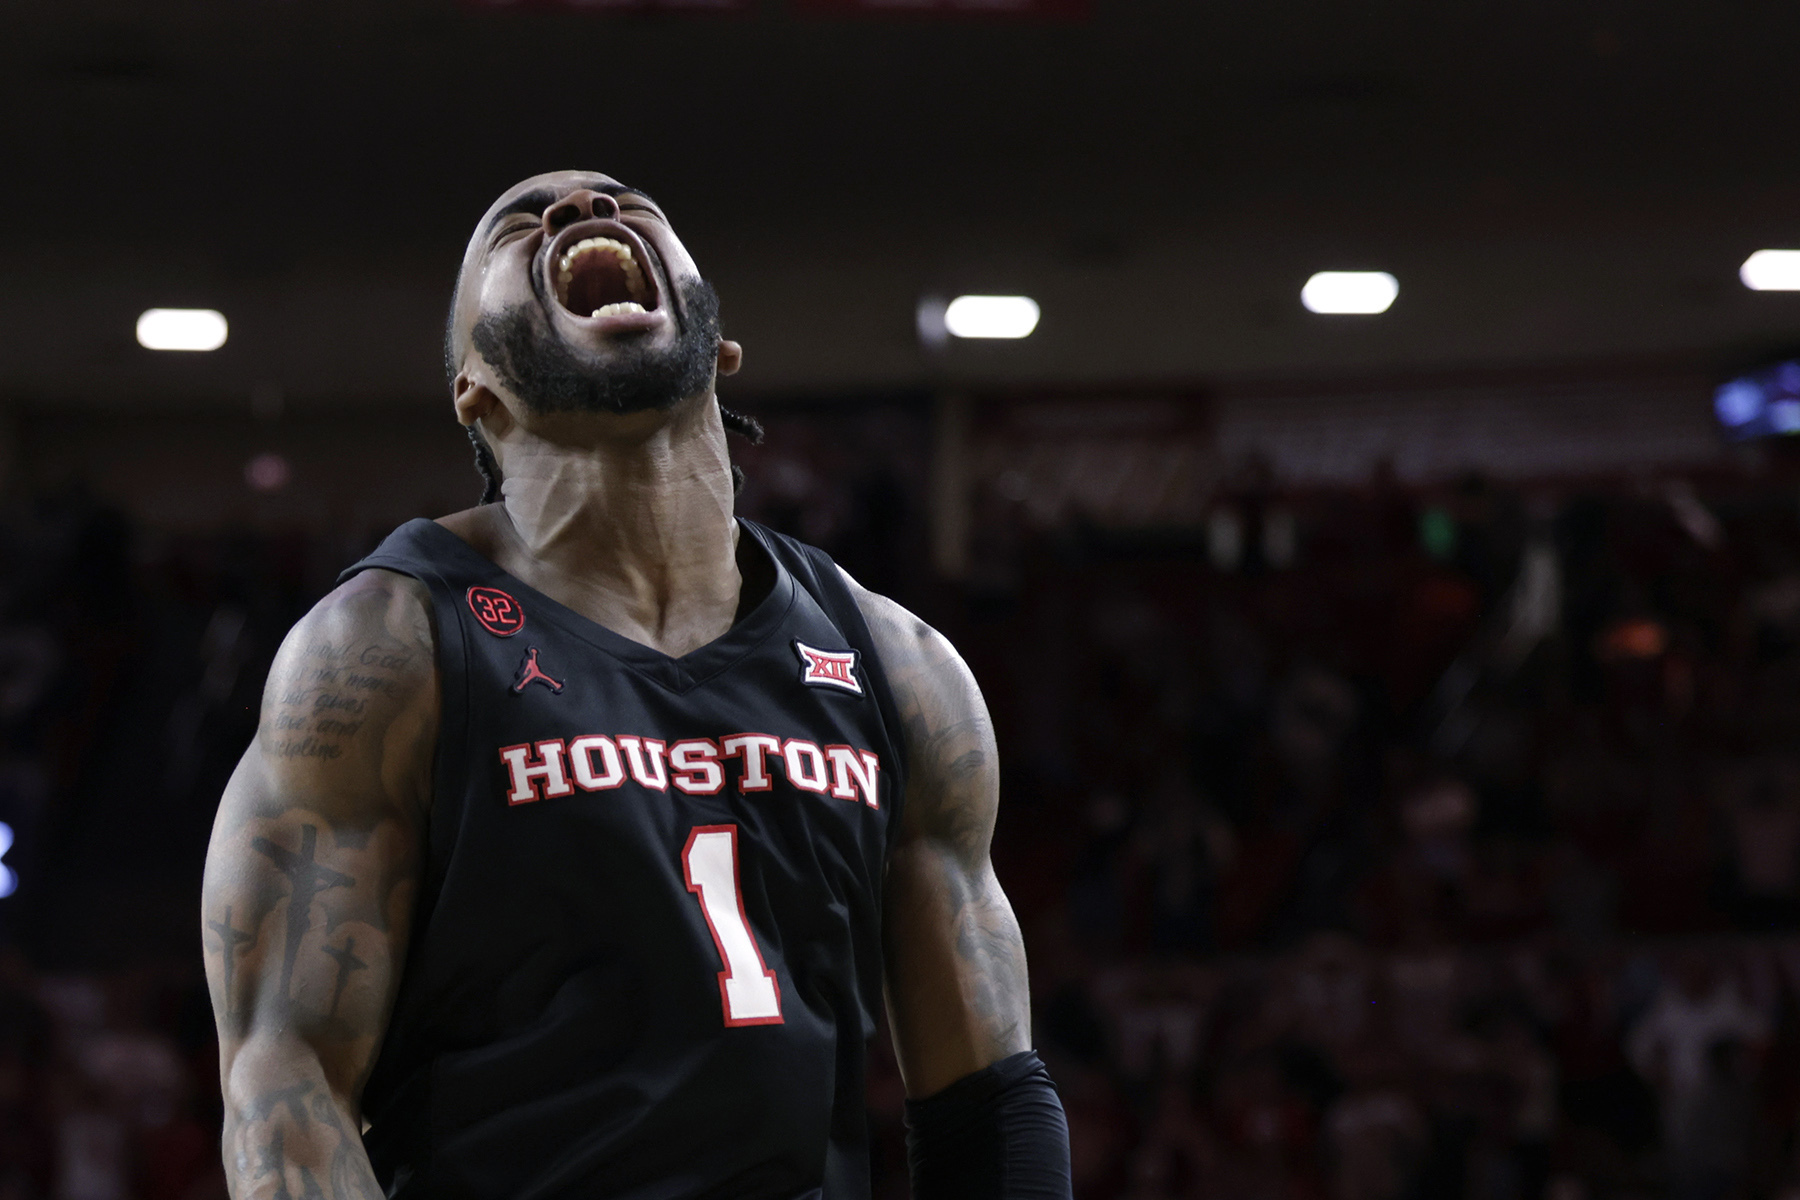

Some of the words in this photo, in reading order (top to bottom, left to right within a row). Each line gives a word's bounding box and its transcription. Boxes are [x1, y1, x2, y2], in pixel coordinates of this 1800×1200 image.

[475, 593, 518, 624] 32
[803, 649, 856, 686] XII
[500, 732, 880, 810] HOUSTON
[681, 824, 785, 1028] 1
